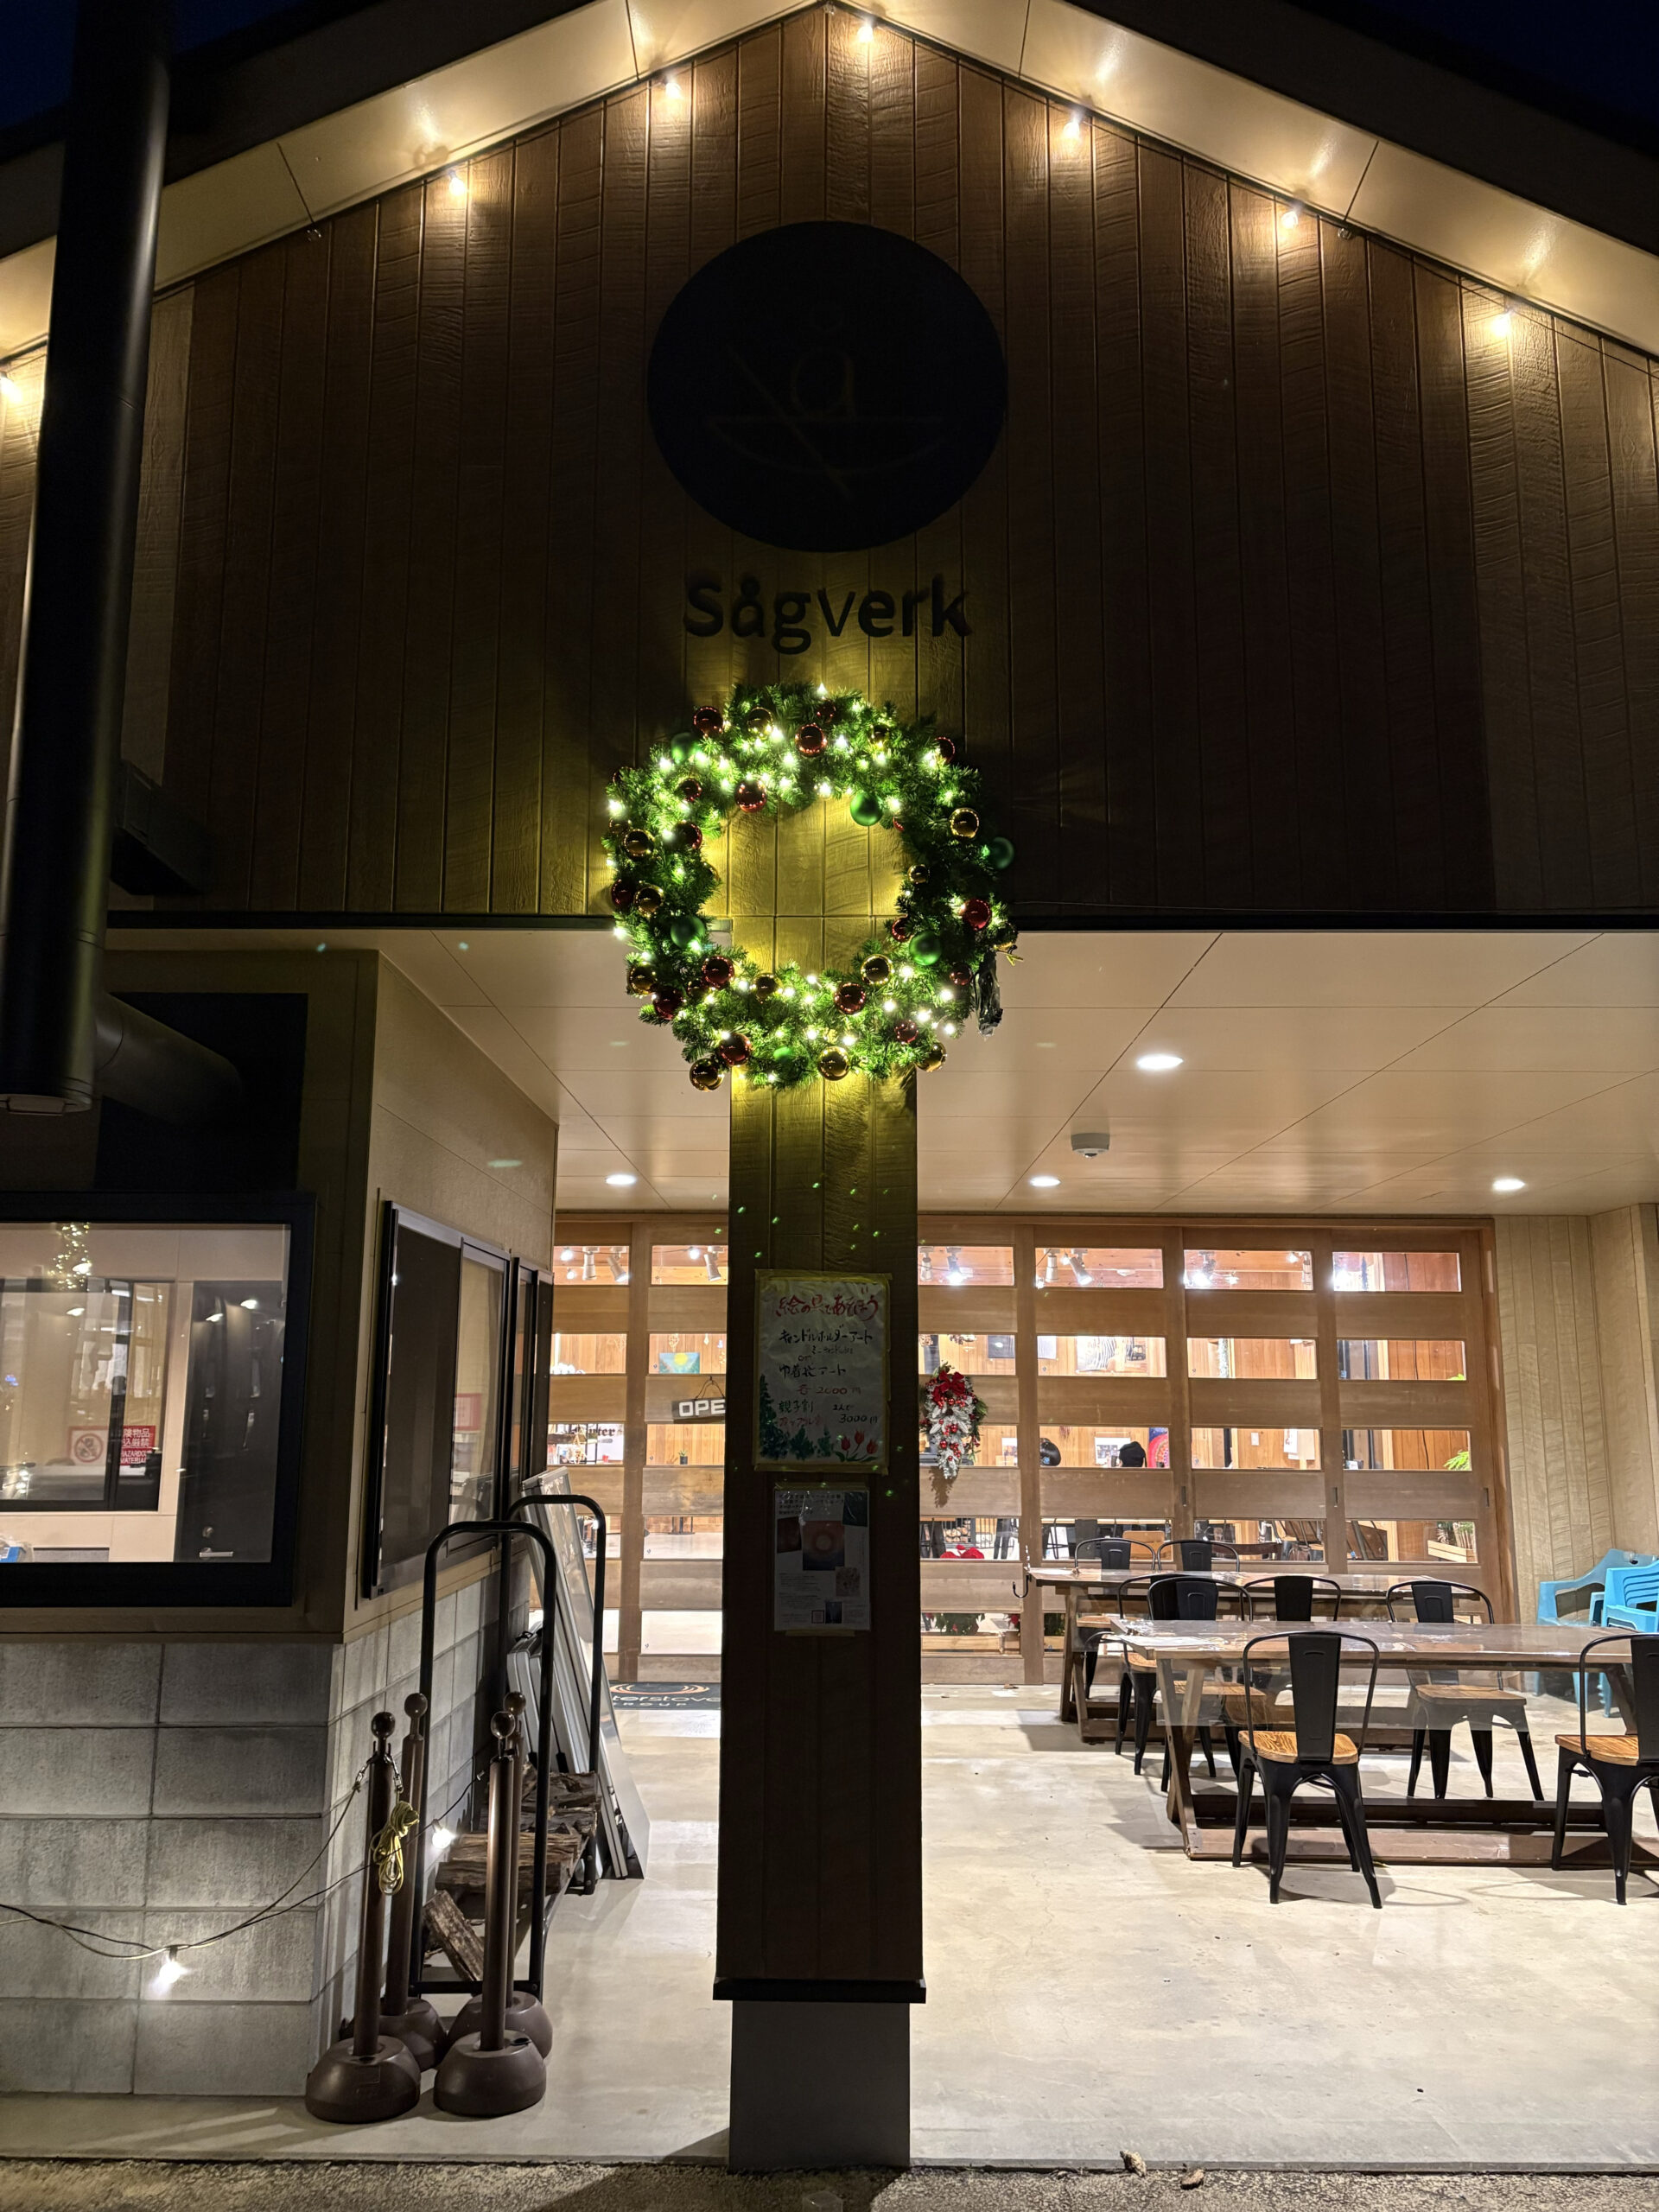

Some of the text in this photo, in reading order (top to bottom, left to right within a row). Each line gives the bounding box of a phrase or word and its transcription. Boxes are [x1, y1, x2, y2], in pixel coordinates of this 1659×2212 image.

[684, 576, 971, 654] Sågverk
[678, 1399, 726, 1417] OPE
[124, 1428, 150, 1438] 険物品
